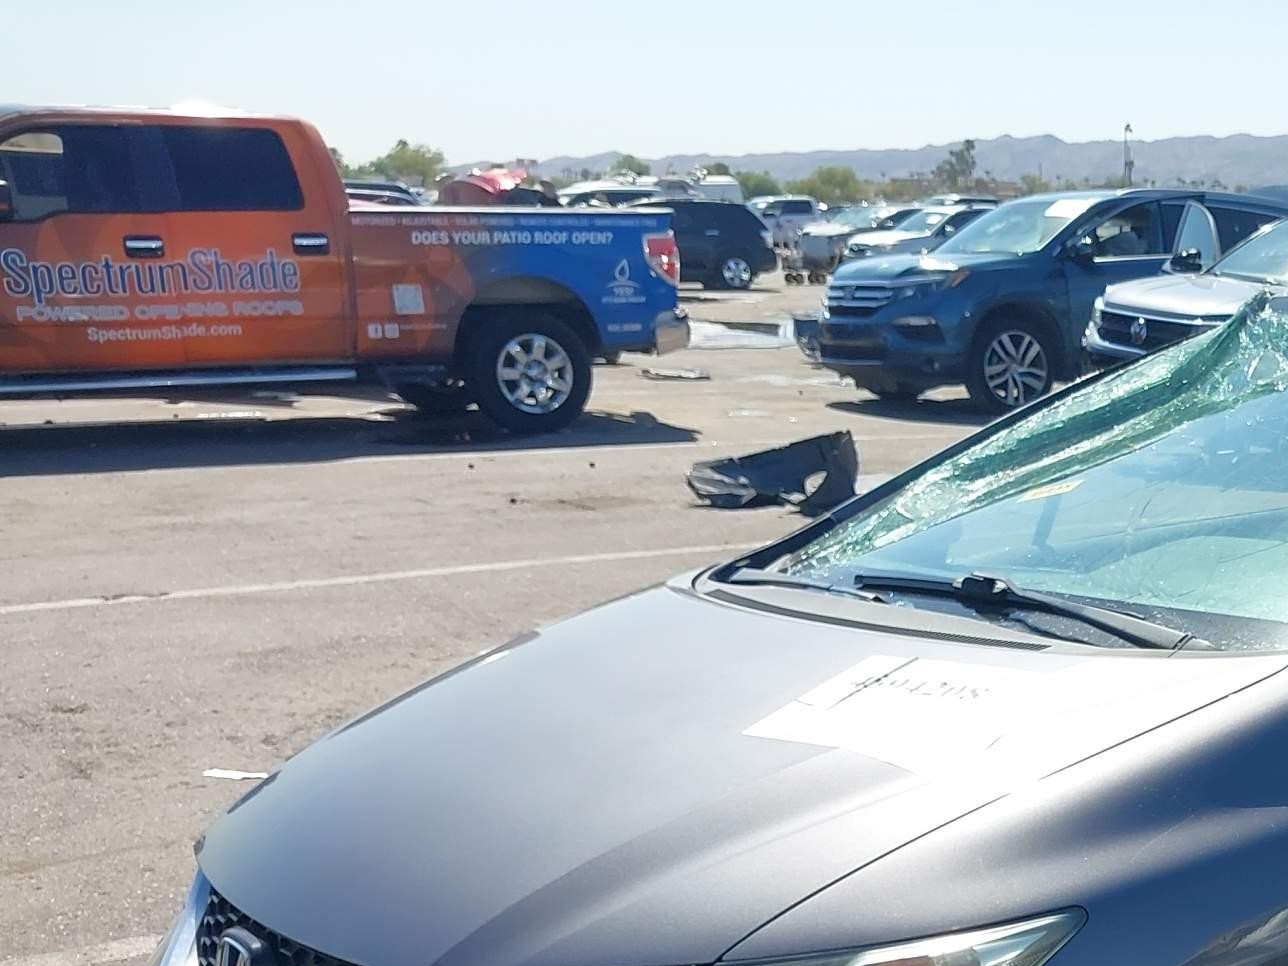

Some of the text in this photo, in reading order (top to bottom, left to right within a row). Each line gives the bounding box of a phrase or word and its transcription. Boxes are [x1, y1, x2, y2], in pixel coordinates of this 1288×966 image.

[412, 230, 614, 245] DOES YOUR PATIO ROOF OPEN?
[1, 247, 300, 304] SpectrumShade
[16, 304, 130, 321] POWERED
[233, 300, 305, 316] ROOFS
